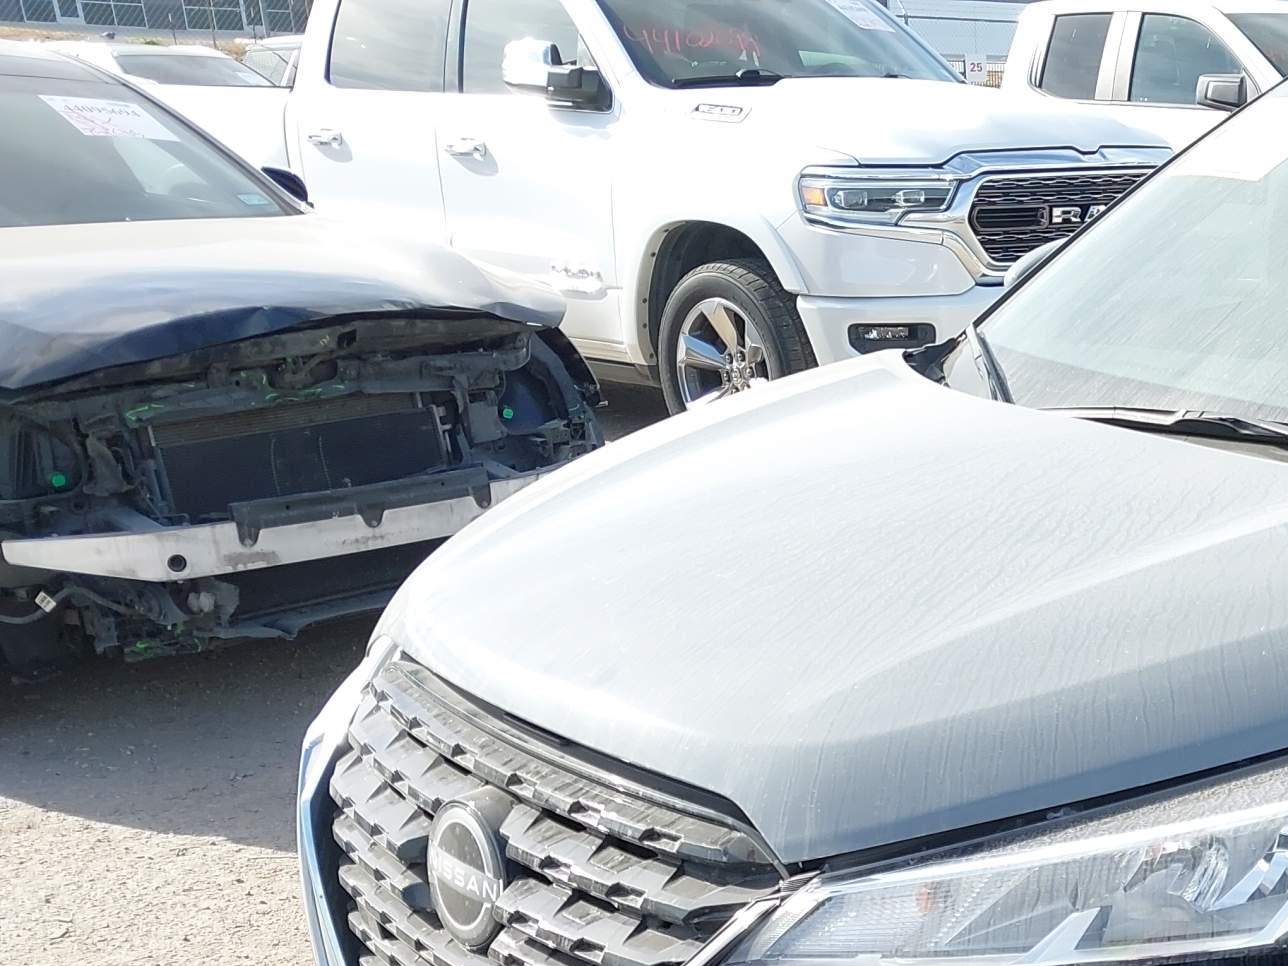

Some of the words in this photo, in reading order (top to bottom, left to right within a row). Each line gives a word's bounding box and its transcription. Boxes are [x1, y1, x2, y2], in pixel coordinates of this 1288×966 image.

[969, 62, 983, 73] 25
[1051, 204, 1108, 224] RA
[429, 847, 498, 903] NISSAN
